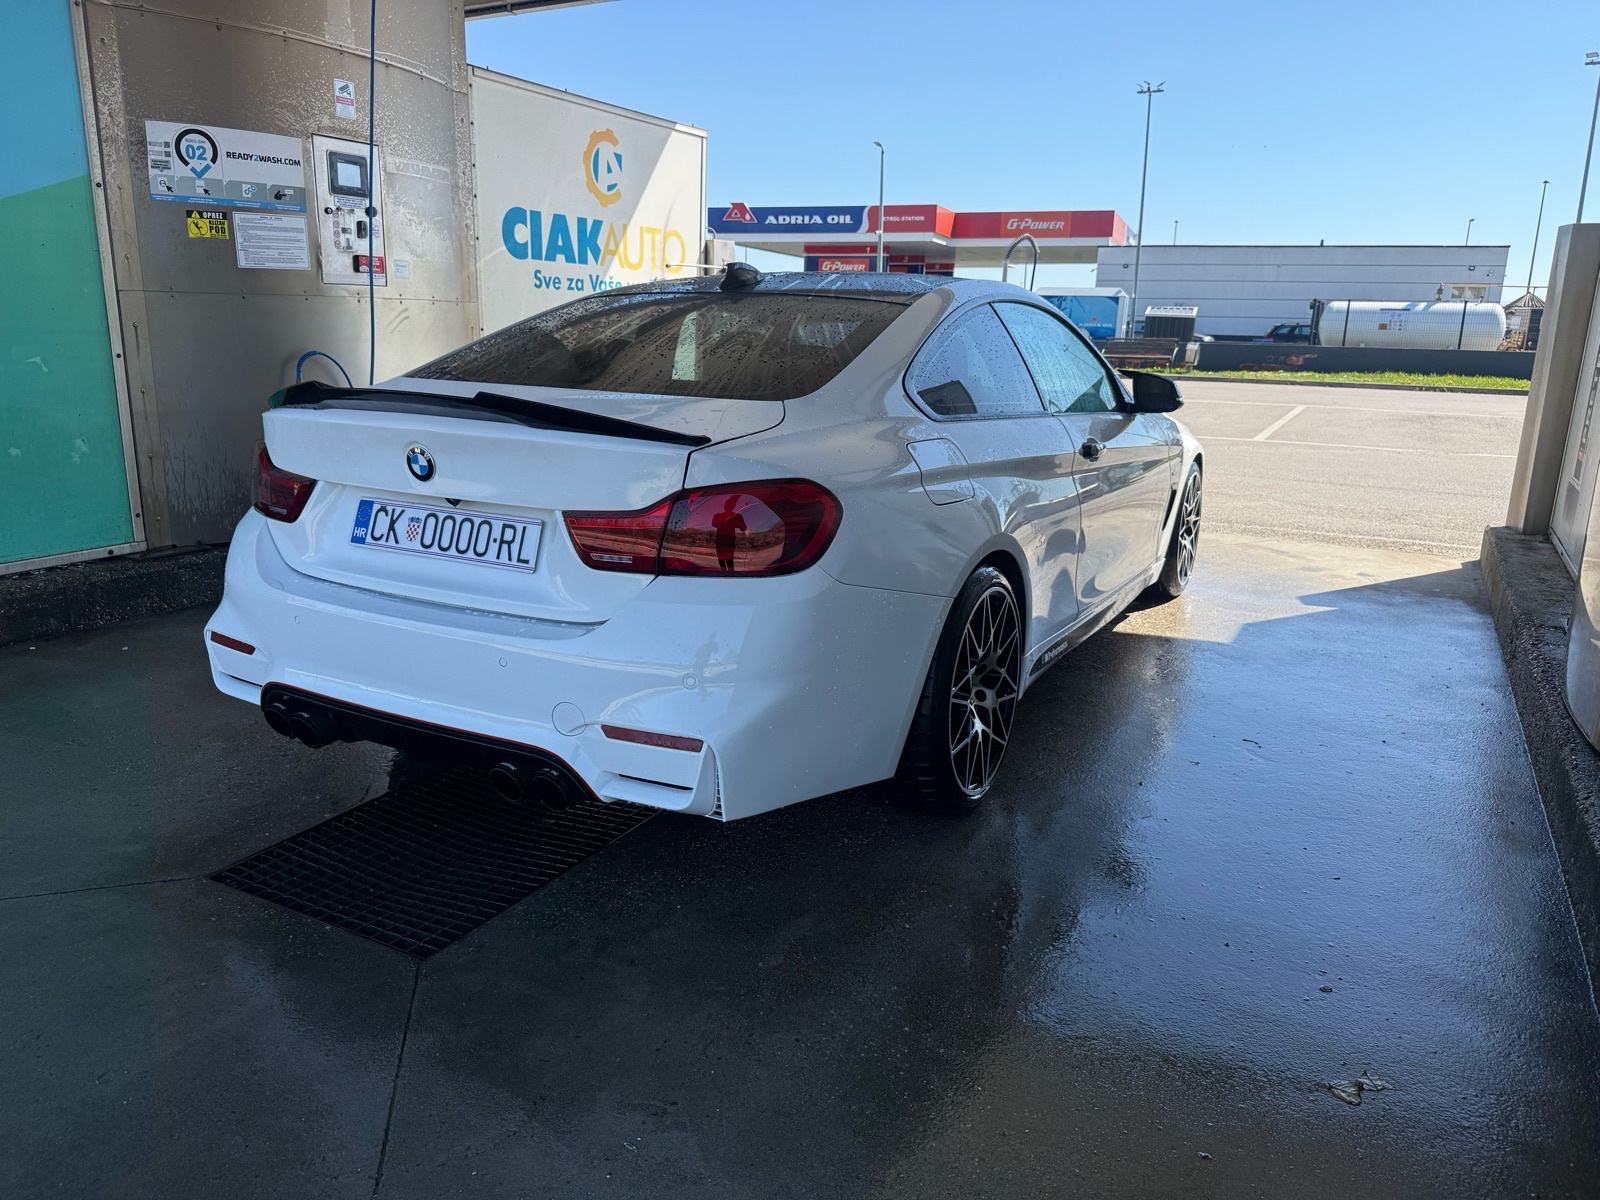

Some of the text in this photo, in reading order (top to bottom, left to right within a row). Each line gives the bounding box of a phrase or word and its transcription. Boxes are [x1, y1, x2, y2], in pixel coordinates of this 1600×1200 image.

[185, 144, 207, 160] 02
[226, 151, 301, 167] READY2WASH.COM
[202, 211, 223, 219] OPREZ
[765, 214, 853, 225] ADRIA OIL
[209, 226, 226, 234] POD
[533, 269, 562, 290] Sve
[566, 277, 585, 291] za
[353, 526, 367, 538] HR
[370, 505, 405, 545] ČK
